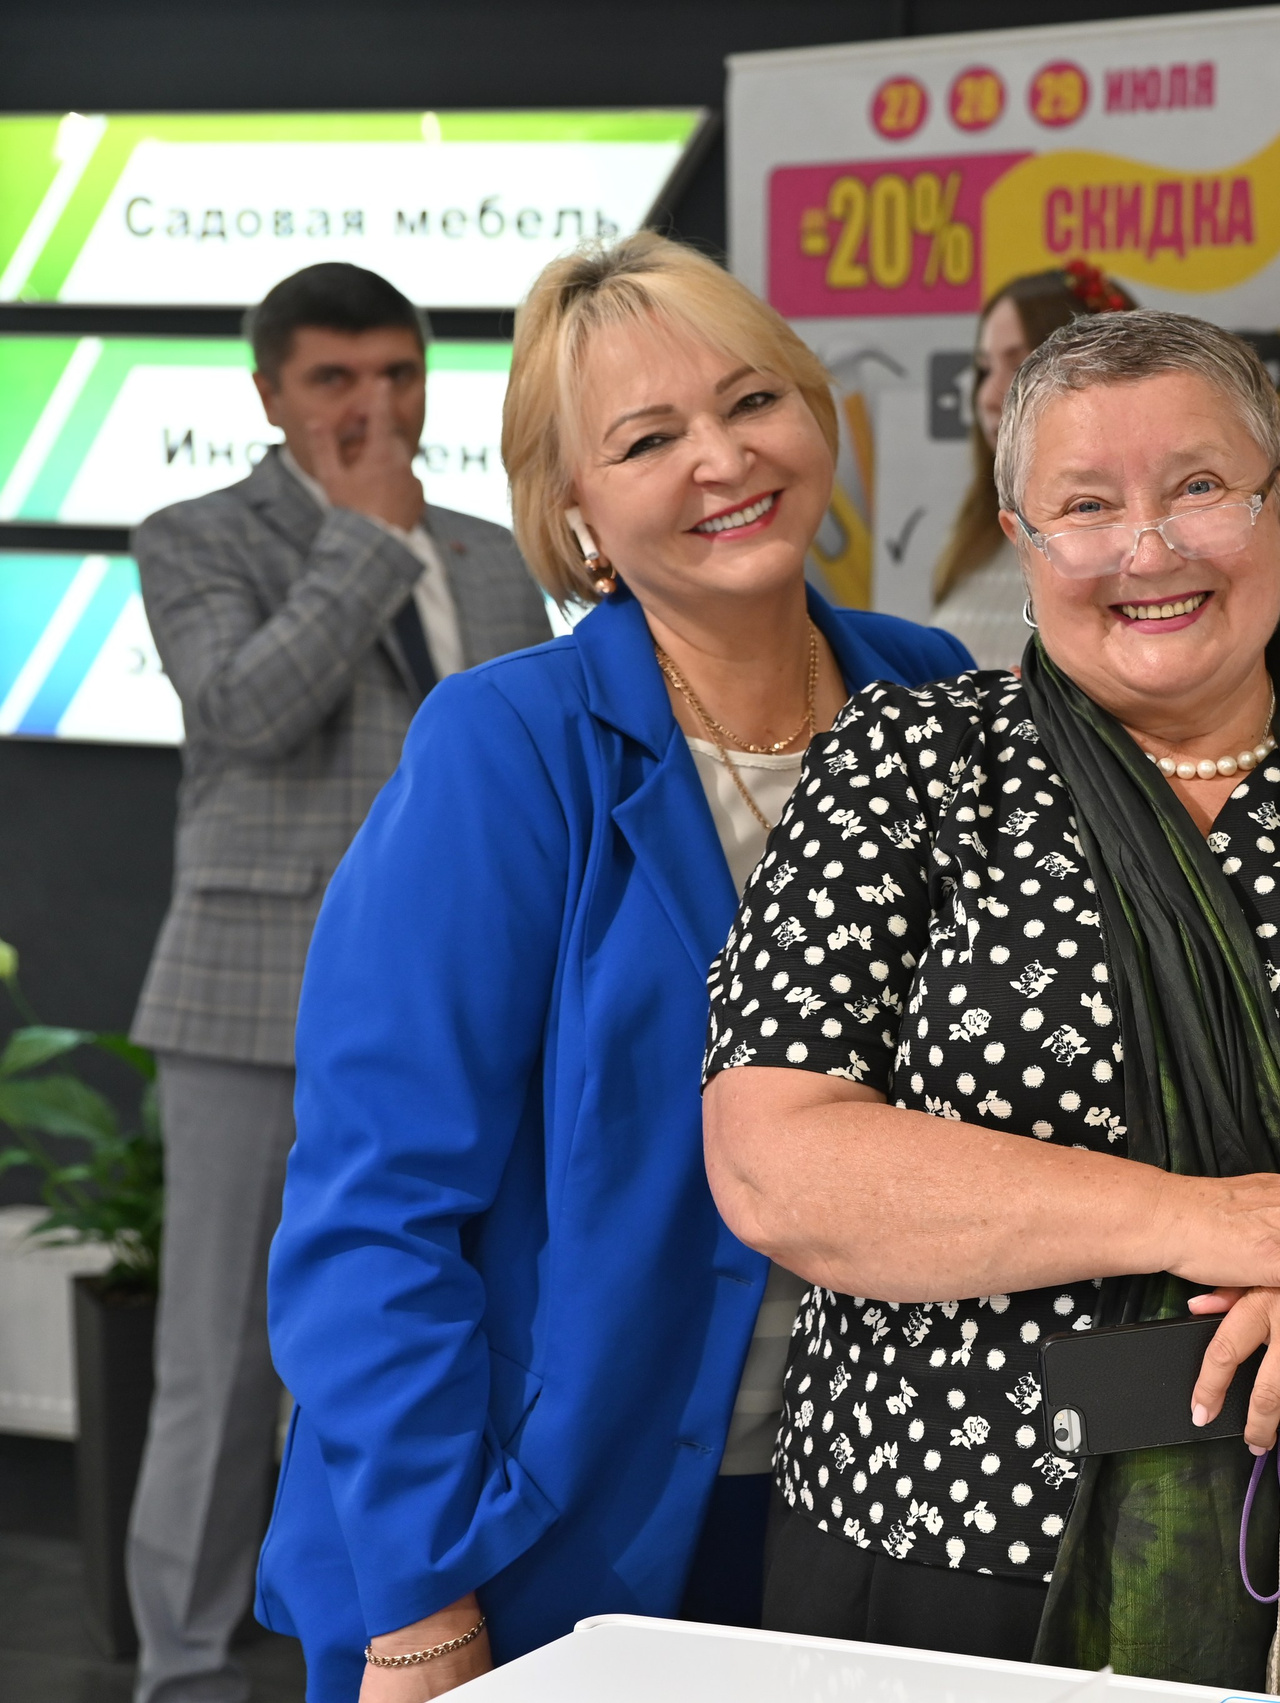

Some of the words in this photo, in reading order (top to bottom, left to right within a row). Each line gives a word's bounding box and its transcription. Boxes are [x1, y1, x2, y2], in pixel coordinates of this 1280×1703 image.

[879, 82, 923, 132] 27
[954, 74, 1003, 124] 28
[1033, 70, 1084, 120] 29
[1103, 62, 1217, 115] ИЮЛЯ
[124, 196, 367, 243] Садовая
[395, 193, 622, 243] мебель
[1043, 175, 1257, 262] СКИДКА
